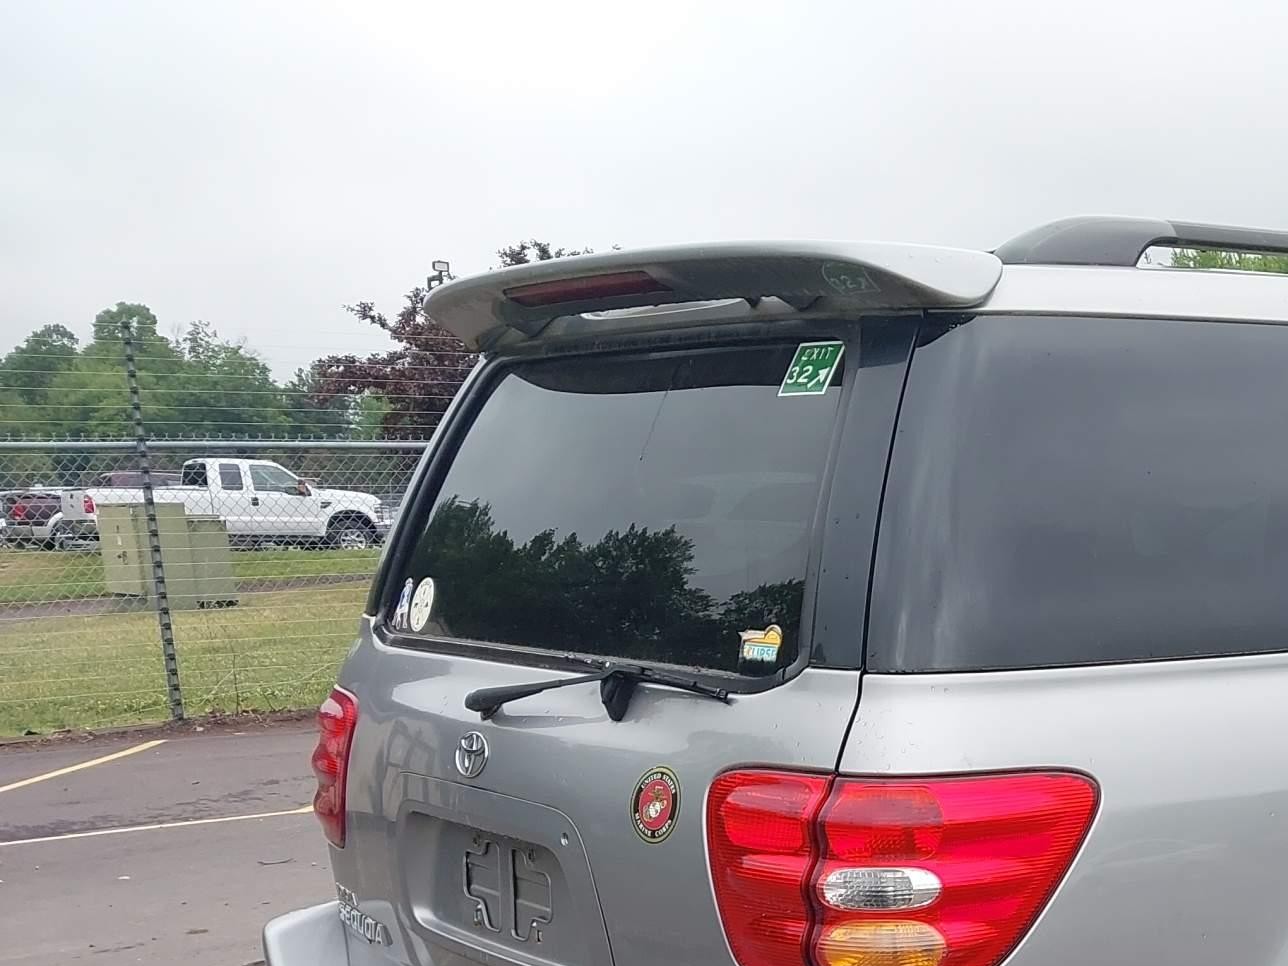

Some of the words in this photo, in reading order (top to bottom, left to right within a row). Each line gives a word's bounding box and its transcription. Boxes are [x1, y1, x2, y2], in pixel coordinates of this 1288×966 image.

[801, 347, 835, 361] EXIT
[787, 366, 813, 383] 32
[640, 773, 662, 790] UNITED
[661, 773, 676, 795] STATES
[634, 812, 652, 837] MARINE
[654, 819, 673, 838] CORPS
[338, 901, 384, 945] SEQUOIA
